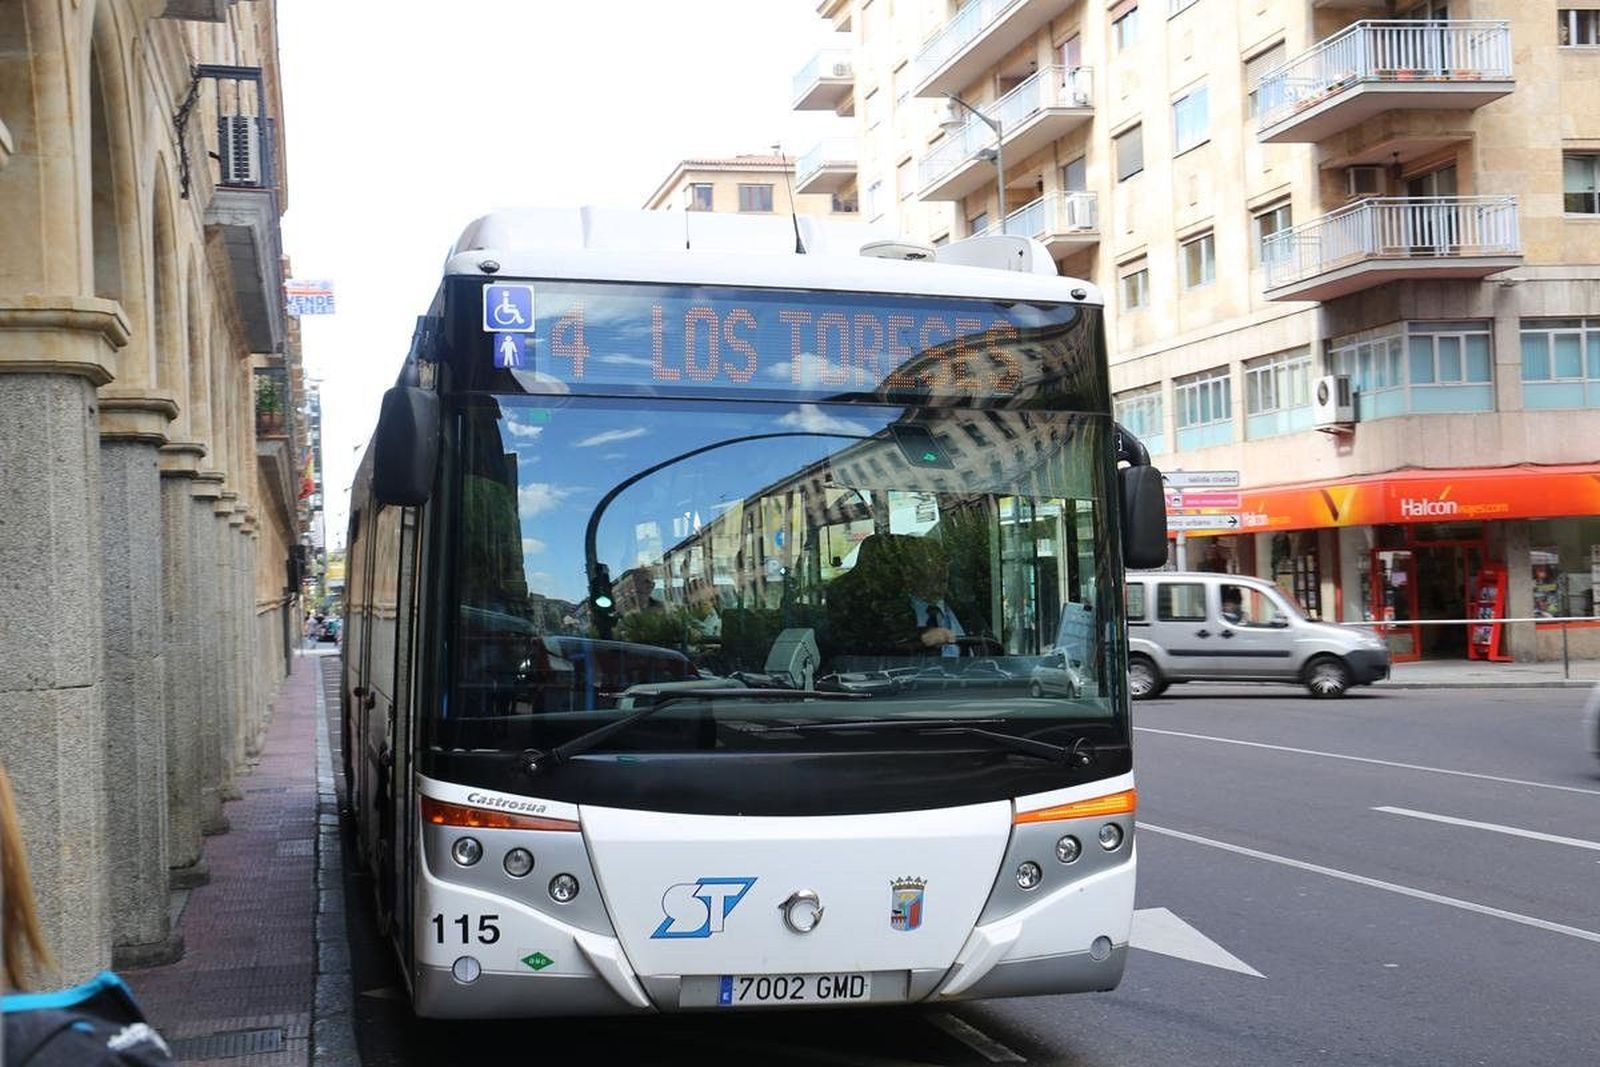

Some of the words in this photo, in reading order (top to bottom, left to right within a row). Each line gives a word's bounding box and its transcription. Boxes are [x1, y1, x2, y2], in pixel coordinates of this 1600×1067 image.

[551, 301, 590, 379] 4
[652, 303, 758, 382] LOS
[779, 309, 1021, 391] TORESES
[466, 792, 547, 814] Castrosua
[432, 913, 501, 945] 115
[739, 976, 805, 1001] 7002
[816, 975, 865, 999] GMD
